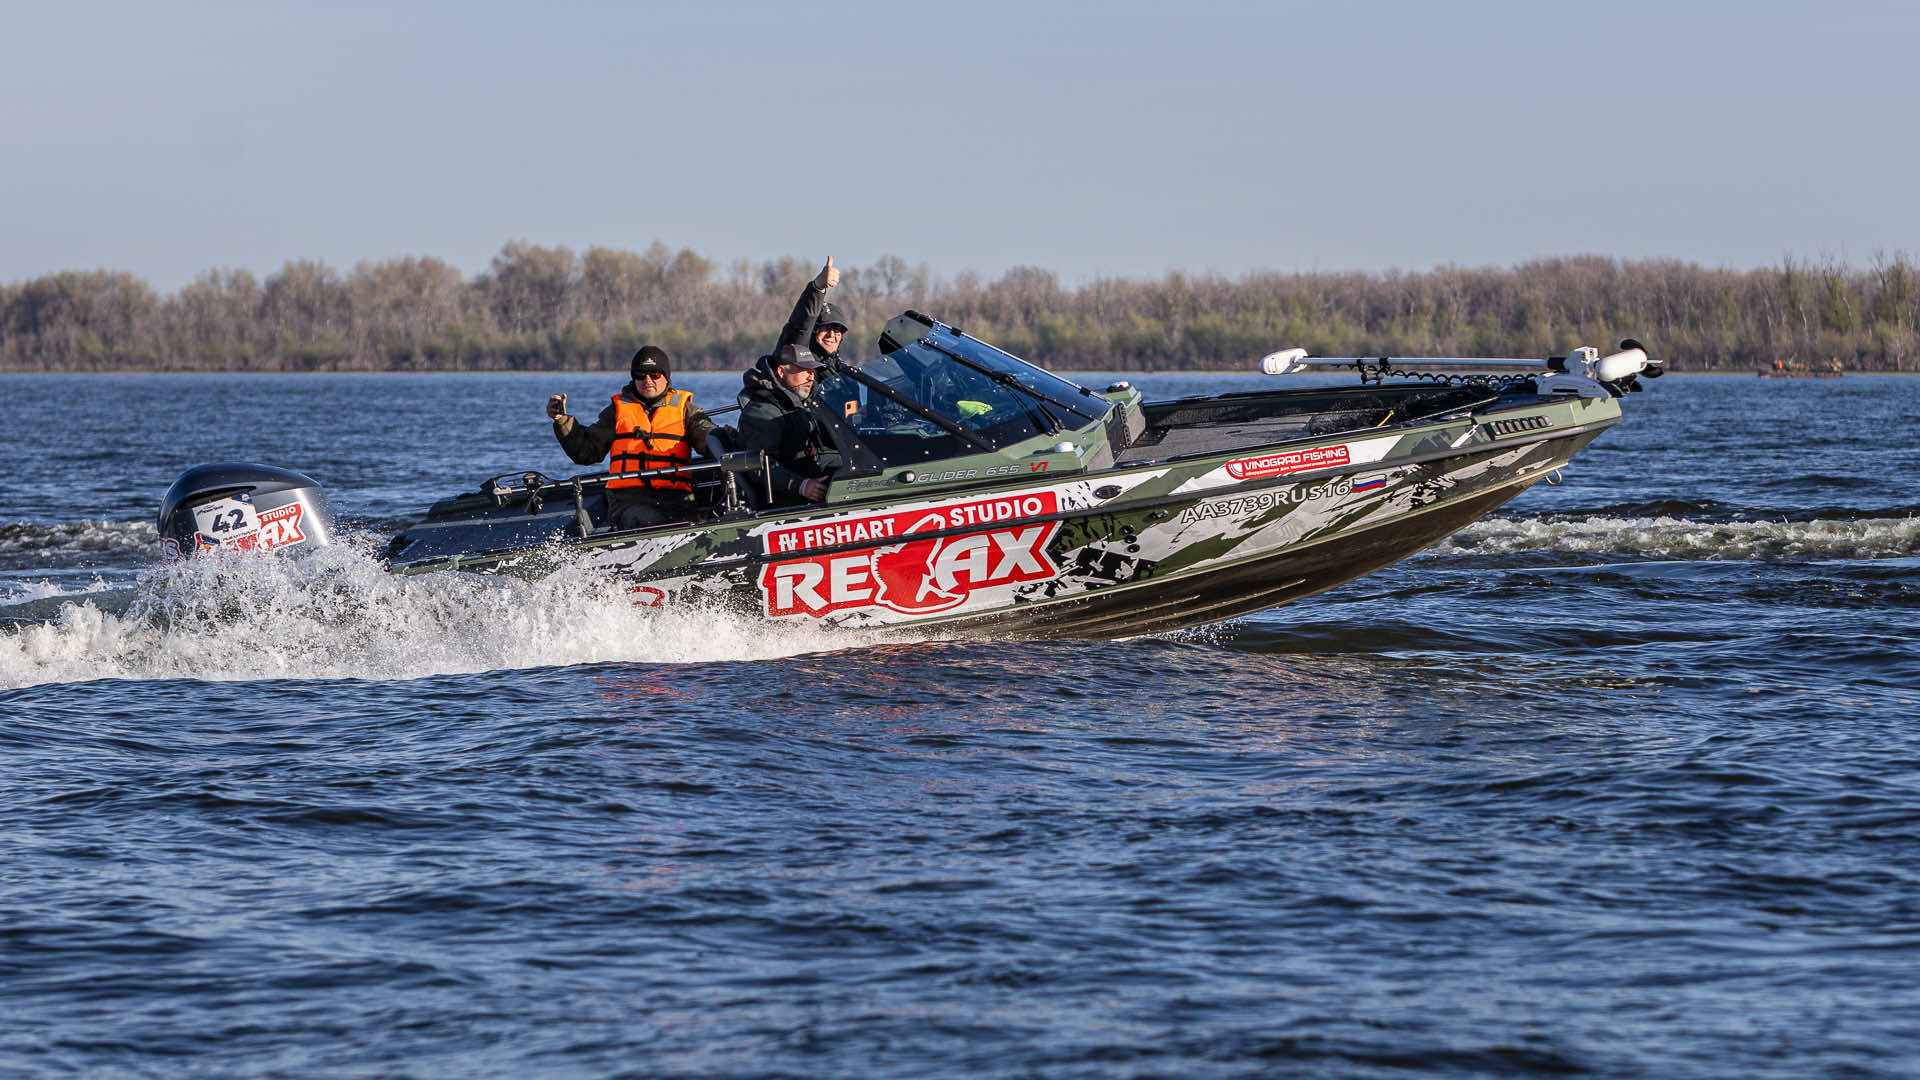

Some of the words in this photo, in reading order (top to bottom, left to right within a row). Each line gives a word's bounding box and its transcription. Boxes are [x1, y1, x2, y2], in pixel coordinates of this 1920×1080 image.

[1243, 454, 1301, 471] VINOGRAD
[1303, 448, 1347, 461] FISHING
[917, 469, 977, 483] GLIDER
[985, 464, 1021, 476] 655
[212, 509, 249, 534] 42
[262, 506, 297, 522] STUDIO
[804, 518, 895, 549] FISHART
[950, 497, 1042, 527] STUDIO
